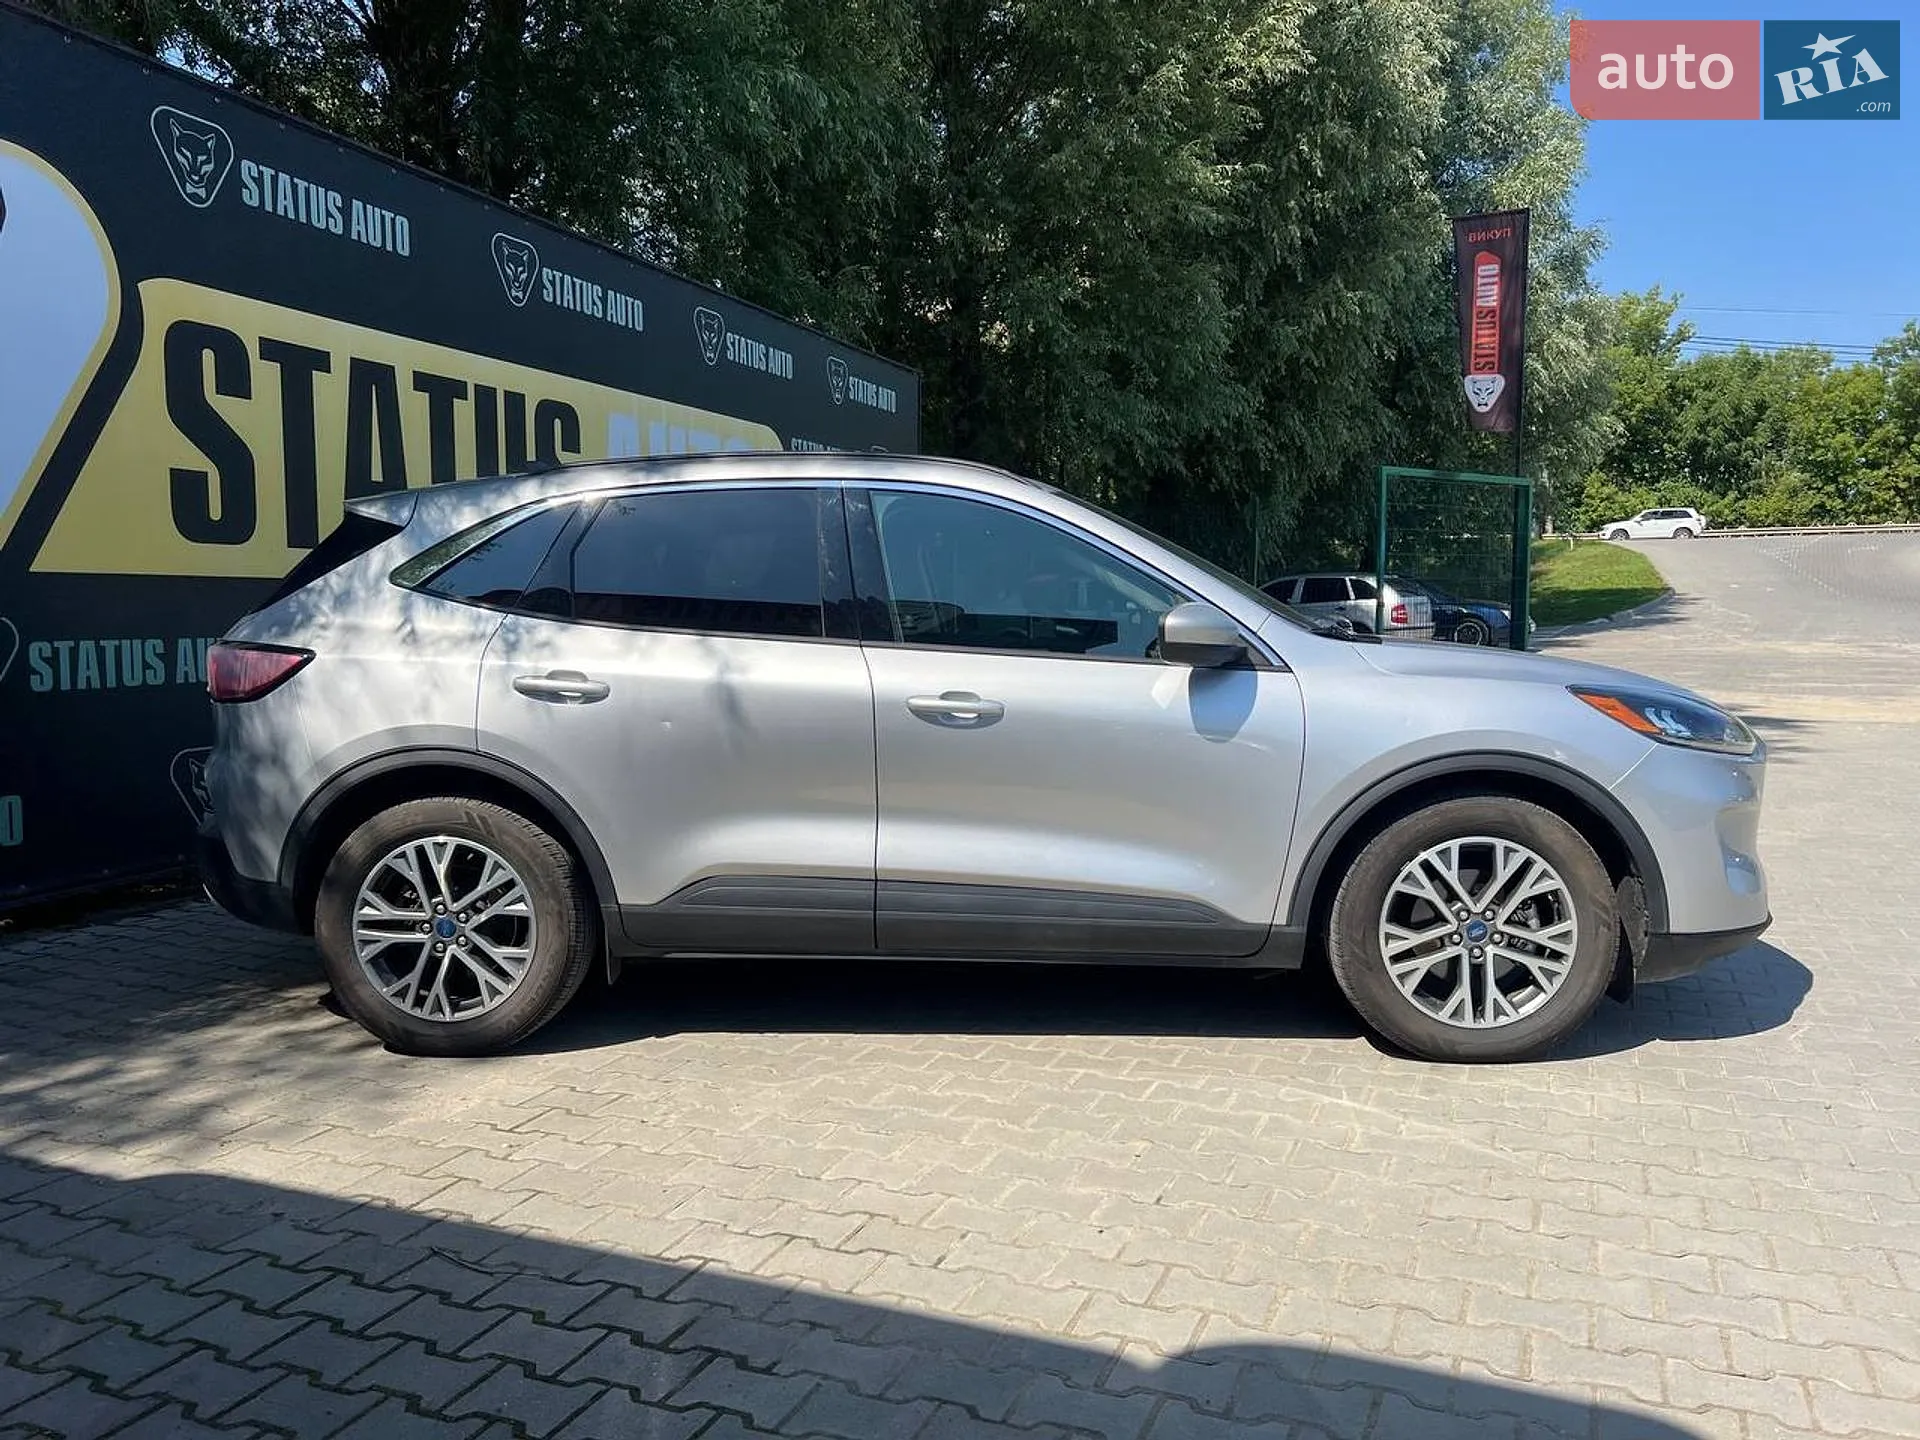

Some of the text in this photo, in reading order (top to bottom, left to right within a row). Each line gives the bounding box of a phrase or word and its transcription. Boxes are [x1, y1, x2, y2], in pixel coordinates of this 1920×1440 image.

[240, 159, 410, 257] STATUS AUTO
[542, 267, 644, 332] STATUS AUTO
[1474, 264, 1500, 371] STATUS AUTO
[726, 332, 794, 380] STATUS AUTO
[849, 375, 897, 413] STATUS AUTO
[28, 637, 218, 692] STATUS AU
